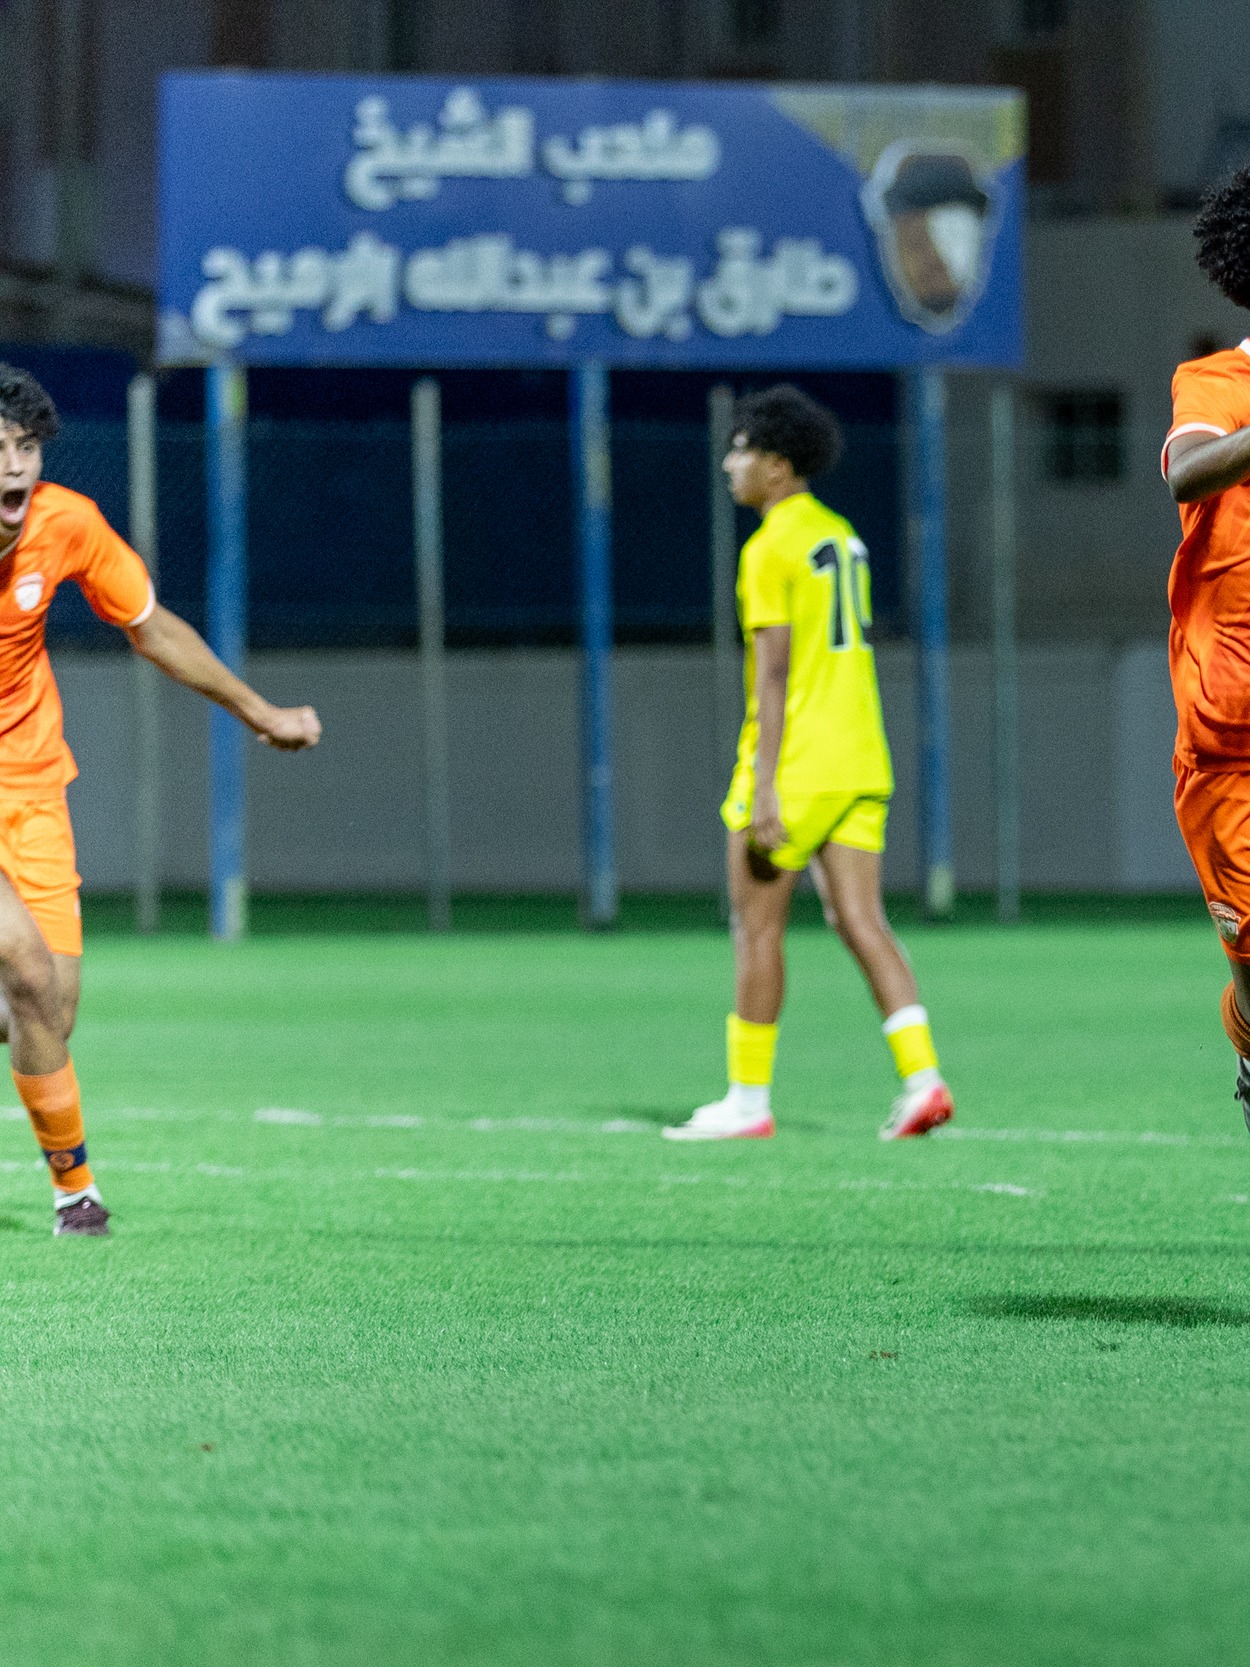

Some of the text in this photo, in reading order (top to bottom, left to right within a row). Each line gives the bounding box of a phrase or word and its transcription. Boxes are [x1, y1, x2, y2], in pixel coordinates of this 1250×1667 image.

[345, 88, 721, 211] ملعب الشيخ
[615, 246, 694, 342] بن
[699, 226, 858, 337] طارق
